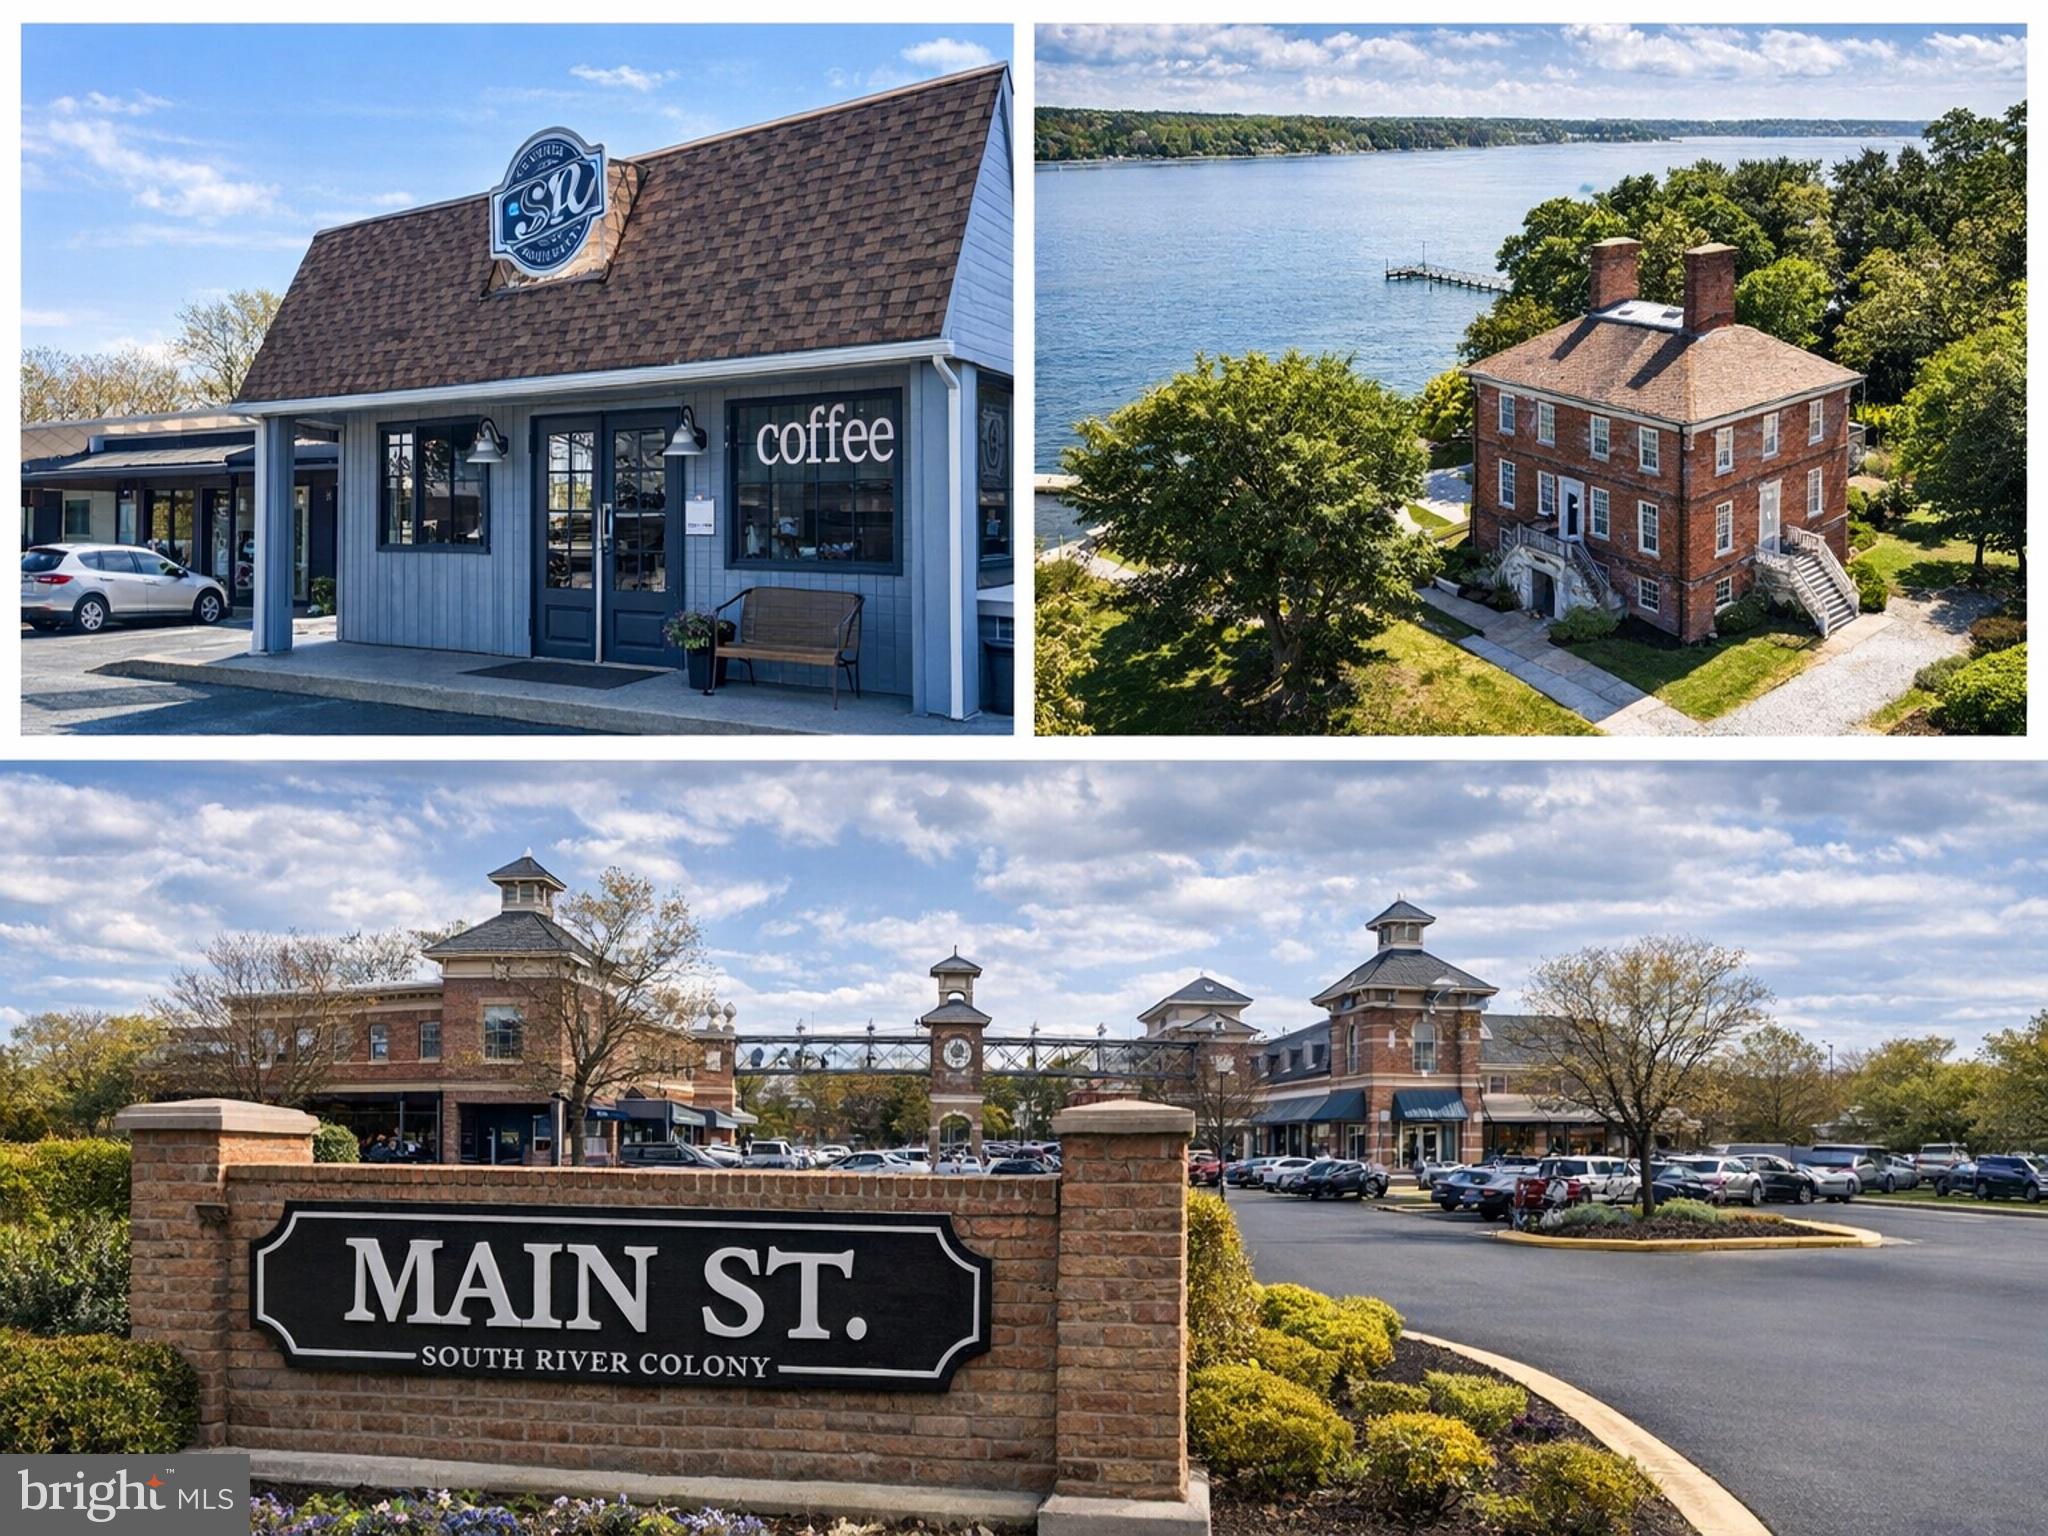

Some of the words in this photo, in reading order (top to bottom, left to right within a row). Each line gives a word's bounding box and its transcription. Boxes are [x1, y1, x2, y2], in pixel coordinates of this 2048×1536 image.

[756, 403, 894, 466] coffee
[343, 1236, 659, 1333] MAIN
[701, 1245, 868, 1341] ST.
[421, 1345, 525, 1370] SOUTH
[535, 1349, 632, 1374] RIVER
[639, 1353, 772, 1379] COLONY
